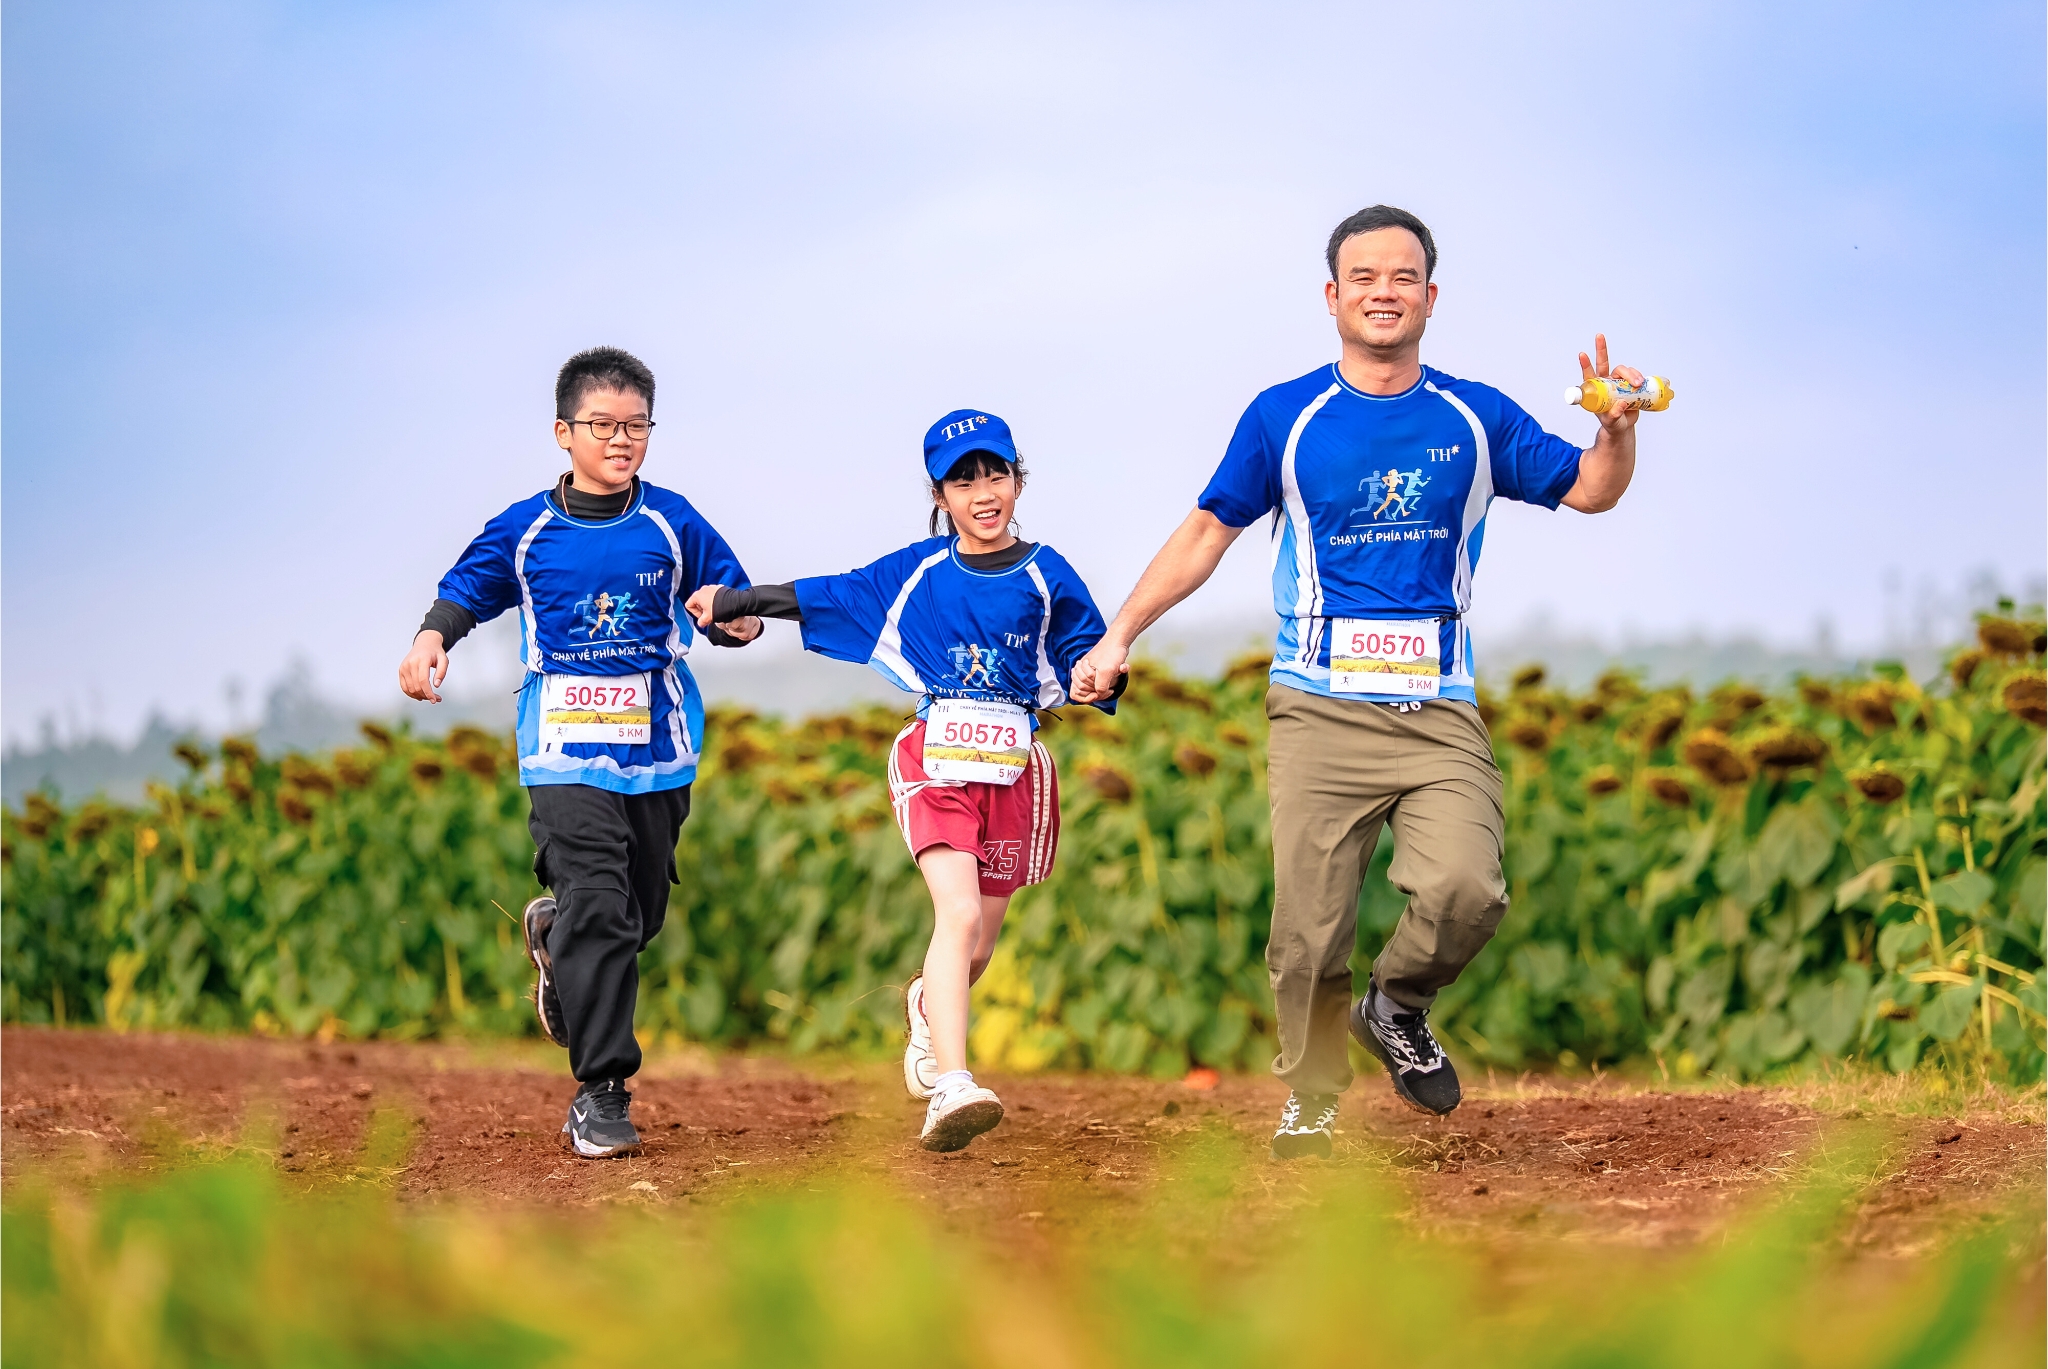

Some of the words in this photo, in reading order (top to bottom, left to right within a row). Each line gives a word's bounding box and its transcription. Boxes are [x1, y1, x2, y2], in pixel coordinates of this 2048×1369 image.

[941, 417, 978, 442] TH
[1426, 448, 1452, 462] TH
[1329, 534, 1358, 547] CHẠY
[1375, 529, 1402, 543] PHÍA
[1428, 526, 1449, 540] TRỜI
[635, 572, 657, 587] TH
[1351, 633, 1425, 657] 50570
[592, 646, 618, 660] PHÍA
[1408, 678, 1414, 689] 5
[1416, 680, 1432, 690] KM
[564, 686, 636, 707] 50572
[618, 727, 625, 738] 5
[627, 728, 643, 738] KM
[944, 722, 1017, 748] 50573
[999, 768, 1005, 778] 5
[1006, 769, 1020, 779] KM
[981, 840, 1022, 874] 75
[982, 871, 1013, 880] SPORTS
